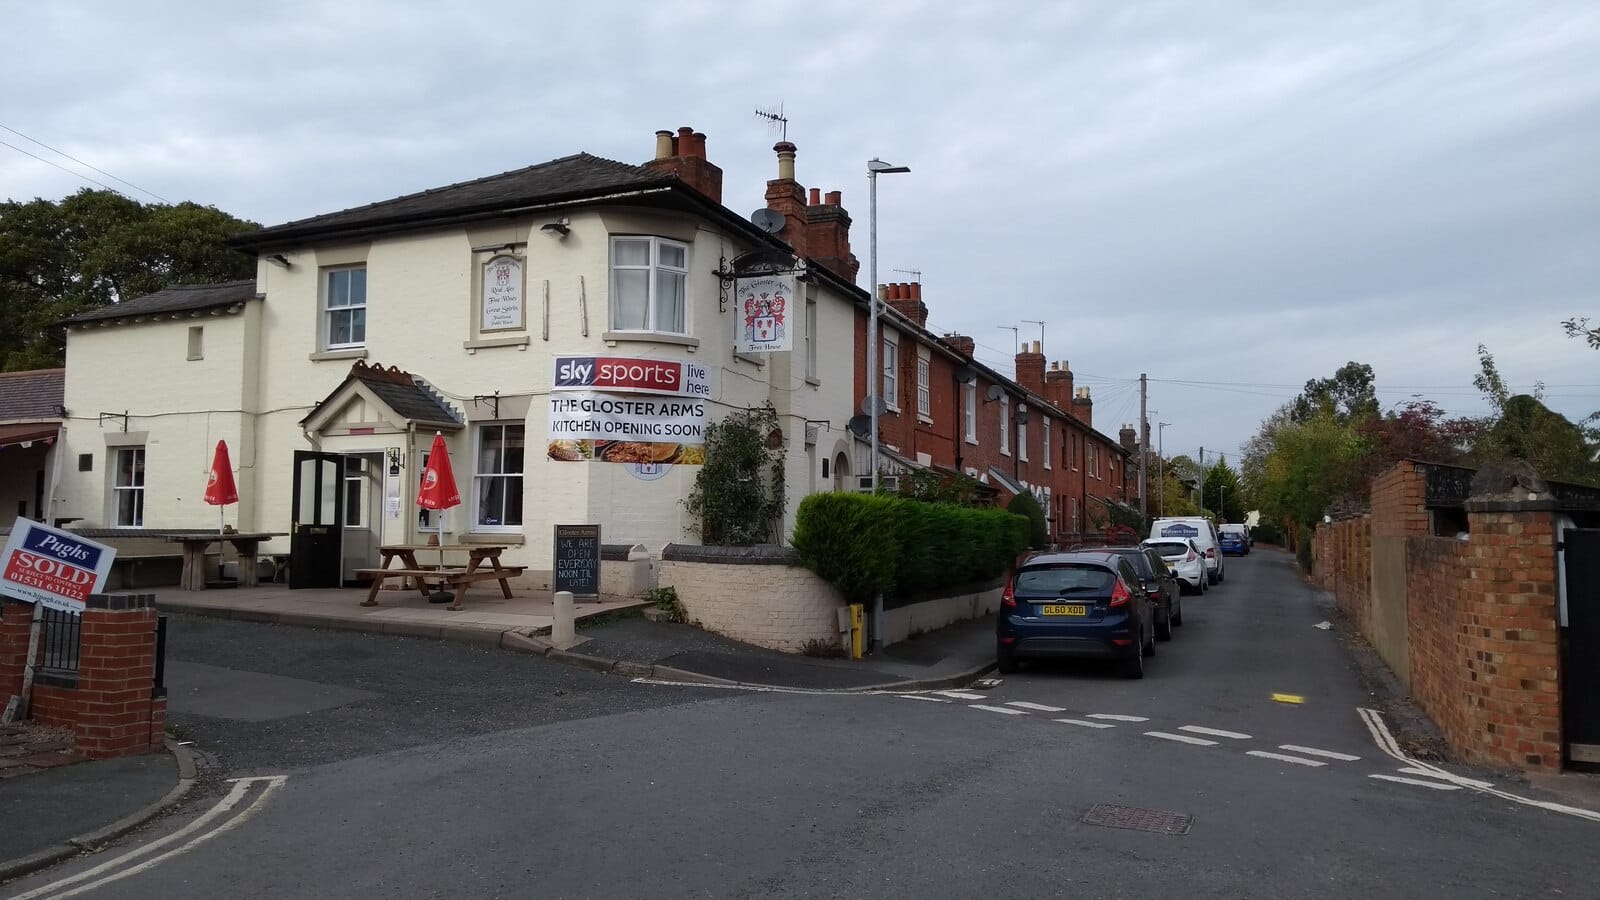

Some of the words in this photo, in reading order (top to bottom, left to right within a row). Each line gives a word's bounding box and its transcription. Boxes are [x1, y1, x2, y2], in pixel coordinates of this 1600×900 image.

[559, 360, 593, 384] sky
[600, 364, 676, 385] sports
[687, 364, 705, 379] live
[686, 380, 710, 396] here
[551, 399, 578, 413] THE
[581, 400, 655, 416] GLOSTER
[658, 403, 705, 417] ARMS
[552, 420, 601, 433] KITCHEN
[604, 421, 662, 436] OPENING
[664, 424, 701, 436] SOON
[35, 535, 90, 560] Pughs
[560, 539, 573, 548] WE
[578, 538, 594, 548] ARE
[567, 549, 591, 558] OPEN
[16, 552, 90, 585] SOLD
[558, 558, 597, 569] EVERYDAY
[558, 569, 578, 578] NOON
[10, 572, 43, 587] 01531
[46, 583, 84, 600] 631122
[1044, 606, 1066, 614] GL60
